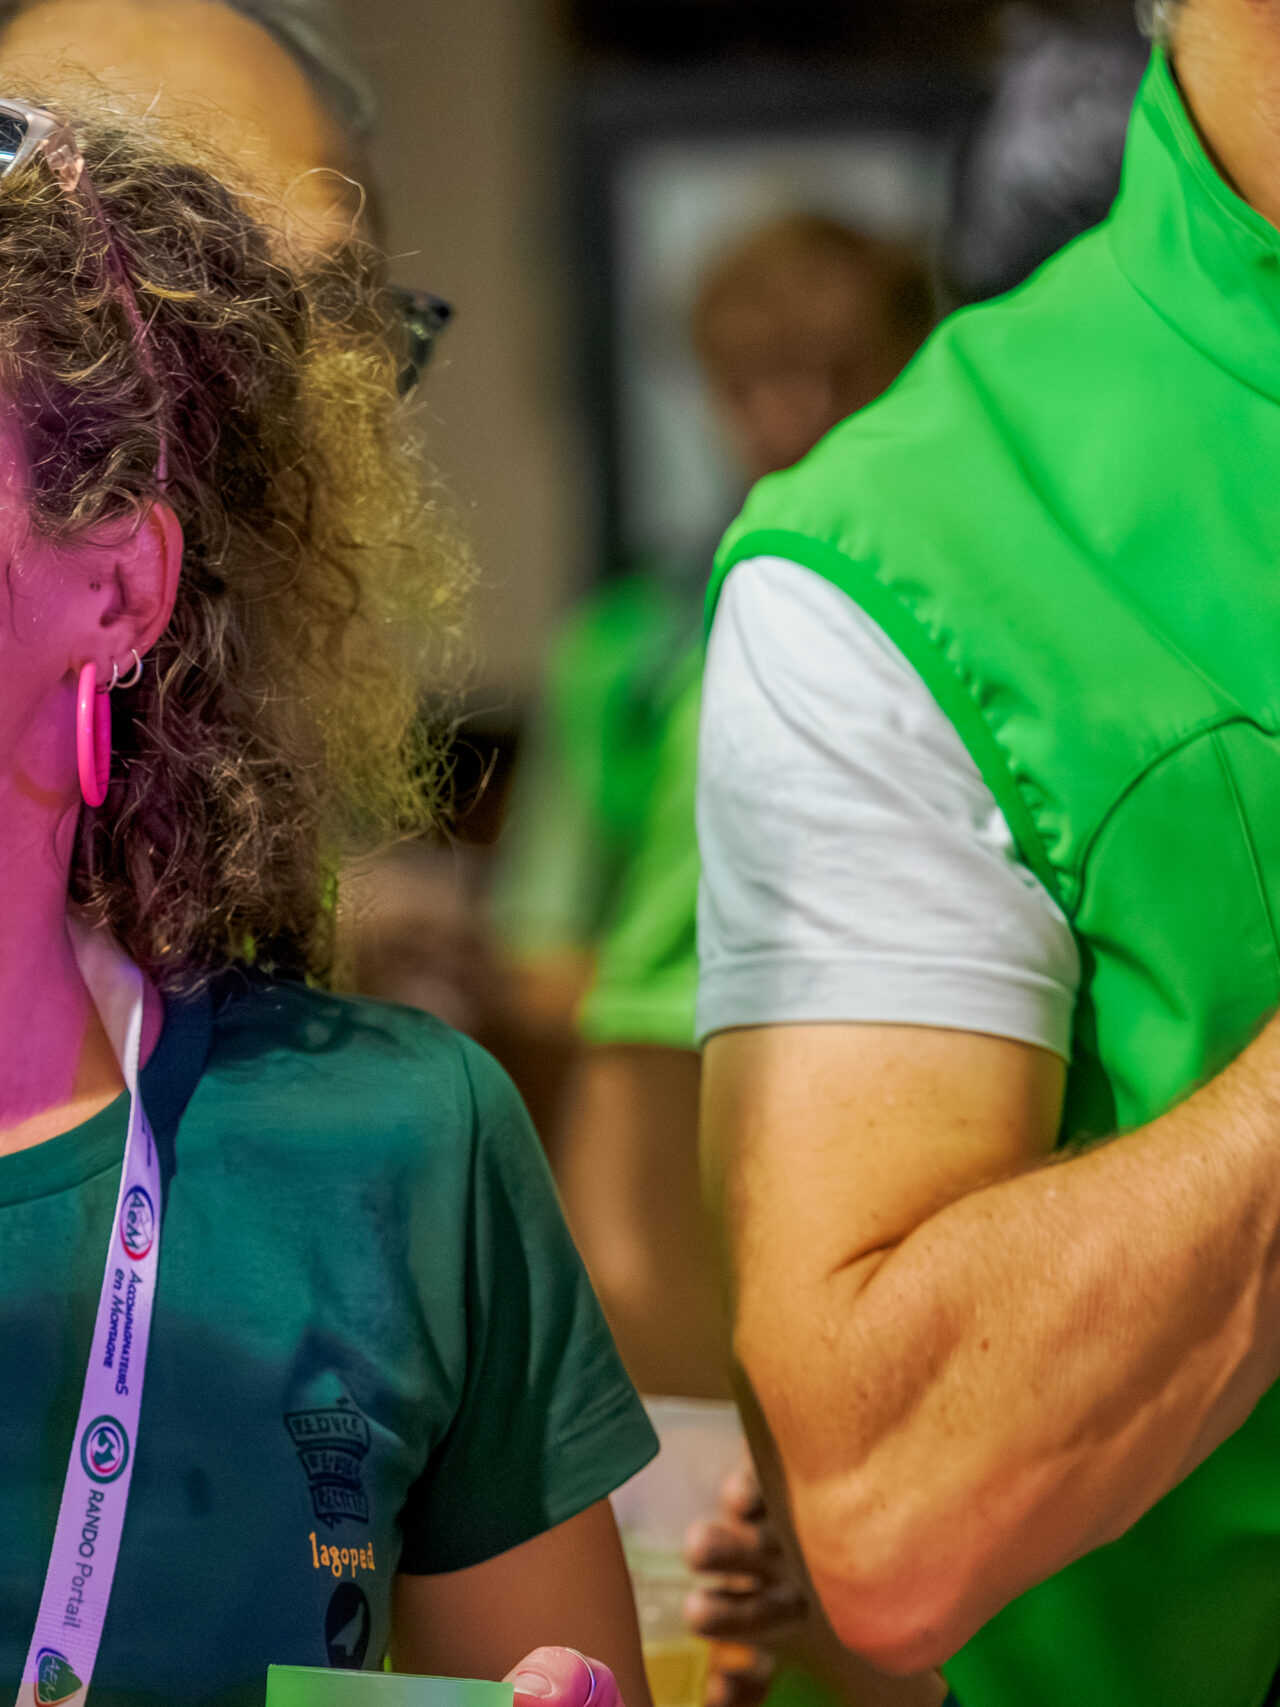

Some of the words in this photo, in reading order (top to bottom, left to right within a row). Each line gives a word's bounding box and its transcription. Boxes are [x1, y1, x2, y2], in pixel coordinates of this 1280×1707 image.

[113, 1268, 125, 1290] en
[78, 1488, 104, 1558] RANDO
[309, 1532, 375, 1578] lagoped
[62, 1561, 93, 1629] Portail
